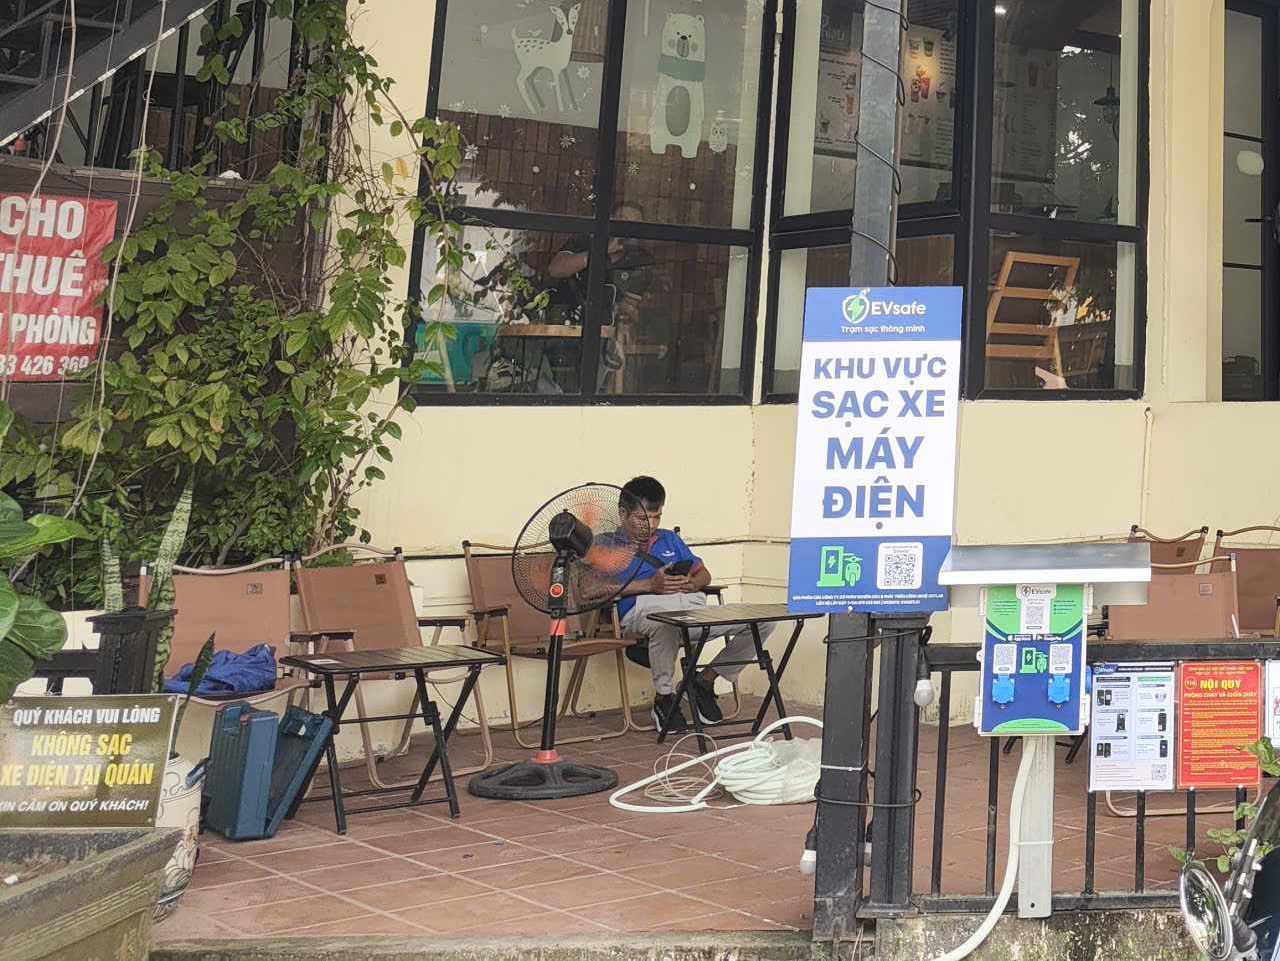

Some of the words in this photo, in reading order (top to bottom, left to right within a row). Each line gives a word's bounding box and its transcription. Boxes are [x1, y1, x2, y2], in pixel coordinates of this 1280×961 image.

[0, 195, 85, 240] CHO
[871, 301, 927, 315] EVsafe
[9, 307, 97, 345] PHÒNG
[840, 325, 863, 334] Trạm
[905, 325, 926, 333] minh
[20, 355, 55, 376] 426
[813, 357, 876, 380] KHU
[883, 353, 948, 385] VỰC
[811, 389, 890, 428] SẠC
[898, 389, 946, 418] XE
[825, 426, 925, 470] MÁY
[822, 475, 926, 530] ĐIỆN
[1200, 678, 1219, 691] NỘI
[1221, 679, 1242, 690] QUY
[13, 706, 43, 726] QUÝ
[44, 706, 93, 725] KHÁCH
[95, 708, 119, 724] VUI
[122, 704, 161, 723] LÒNG
[31, 730, 92, 757] KHÔNG
[96, 733, 133, 760] SẠC
[0, 762, 22, 786] XE
[27, 759, 68, 791] ĐIỆN
[73, 762, 101, 790] TẠI
[104, 758, 155, 788] QUÁN
[18, 797, 46, 812] CẢM
[69, 798, 98, 812] QUÝ
[99, 797, 149, 812] KHÁCH!
